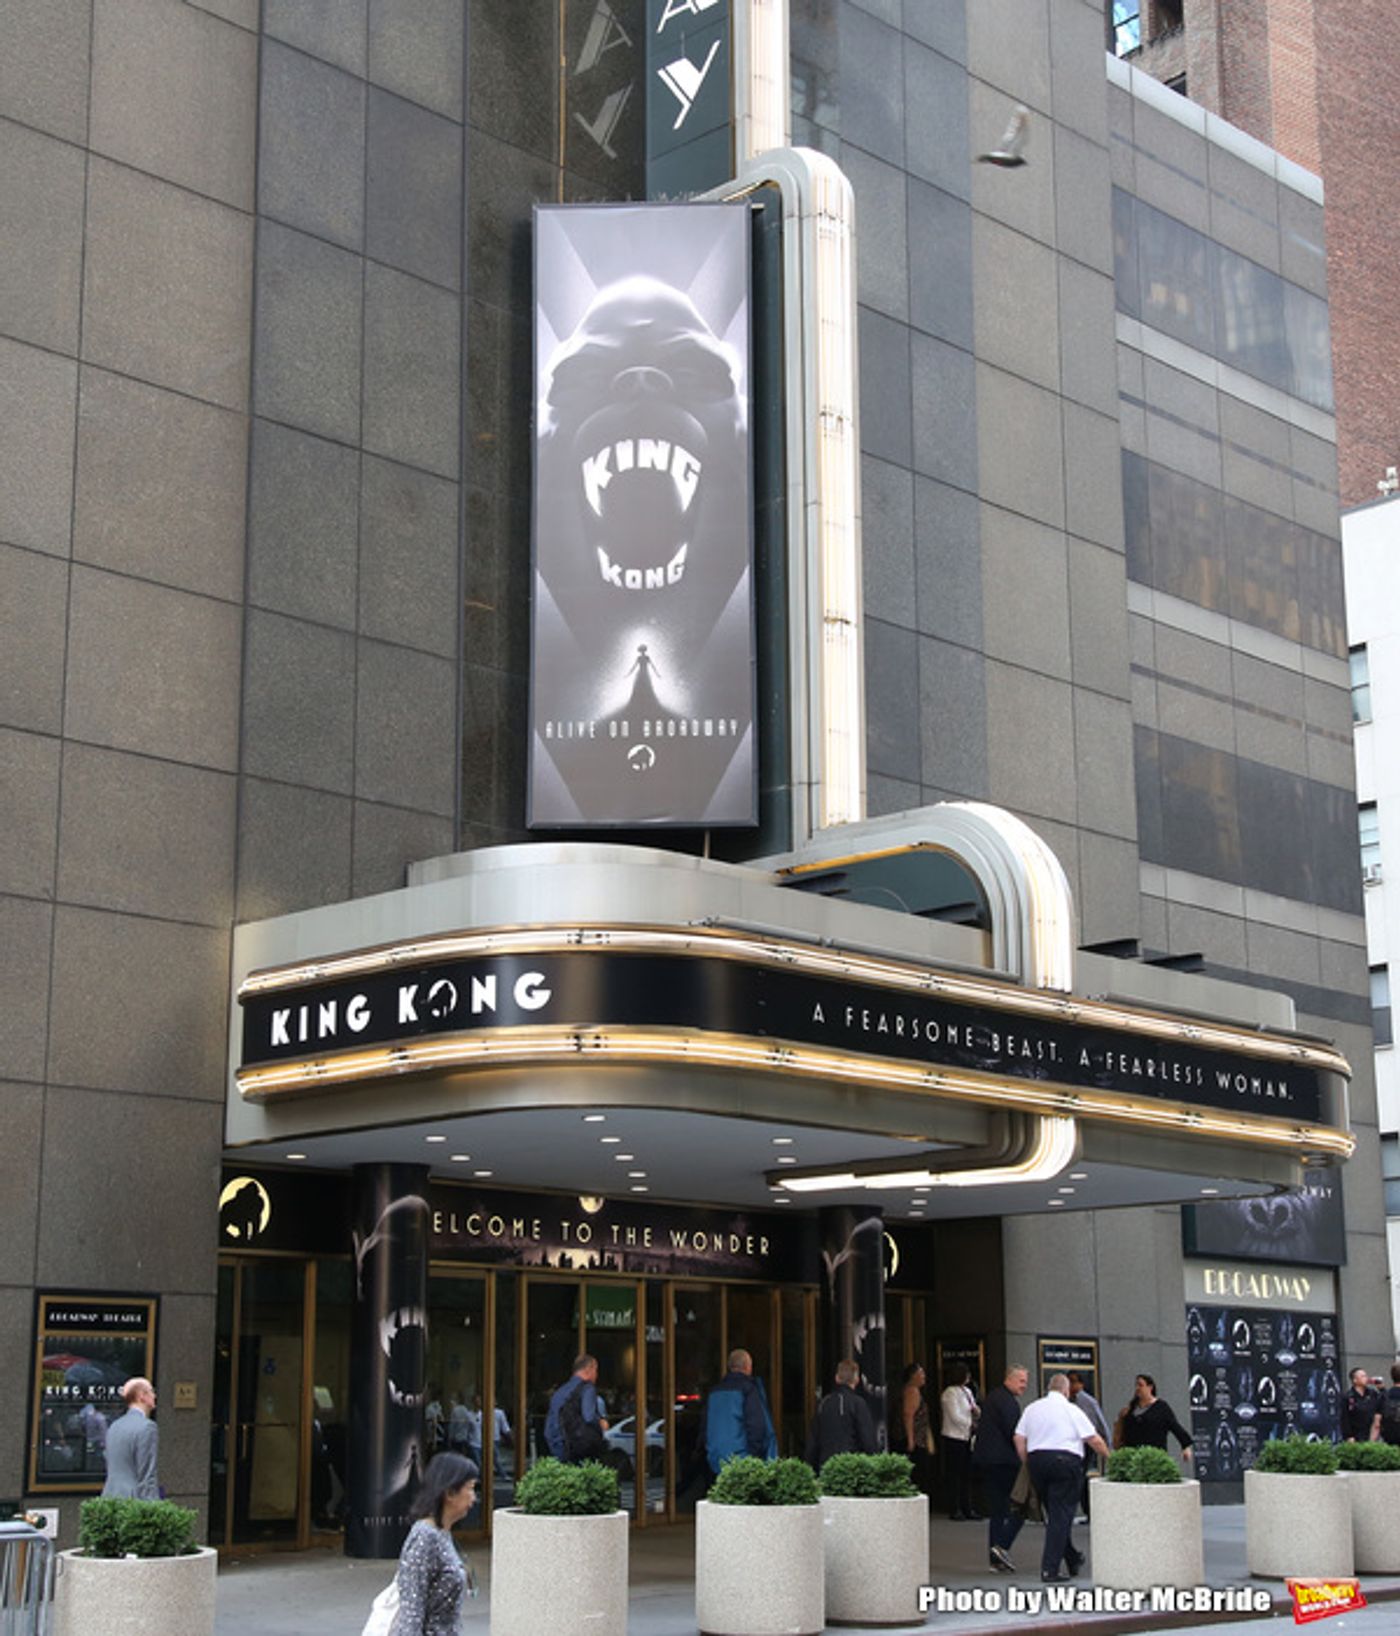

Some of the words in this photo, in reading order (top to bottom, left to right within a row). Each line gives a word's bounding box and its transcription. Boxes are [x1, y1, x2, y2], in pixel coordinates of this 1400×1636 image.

[582, 438, 702, 517] KING
[597, 543, 688, 589] KONG
[545, 720, 597, 739] ALIVE
[643, 718, 740, 738] BROADWAY
[270, 994, 371, 1047] KING
[813, 1003, 825, 1024] A
[846, 1006, 975, 1048] FEARSOME
[990, 1032, 1063, 1063] BEAST.
[1079, 1047, 1091, 1068] A
[1106, 1051, 1204, 1087] FEARLESS
[1215, 1071, 1294, 1101] WOMAN.
[432, 1210, 542, 1241] ELCOME
[560, 1221, 592, 1244] TO
[610, 1224, 652, 1248] THE
[669, 1229, 770, 1256] WONDER
[1203, 1268, 1311, 1302] BROADWAY
